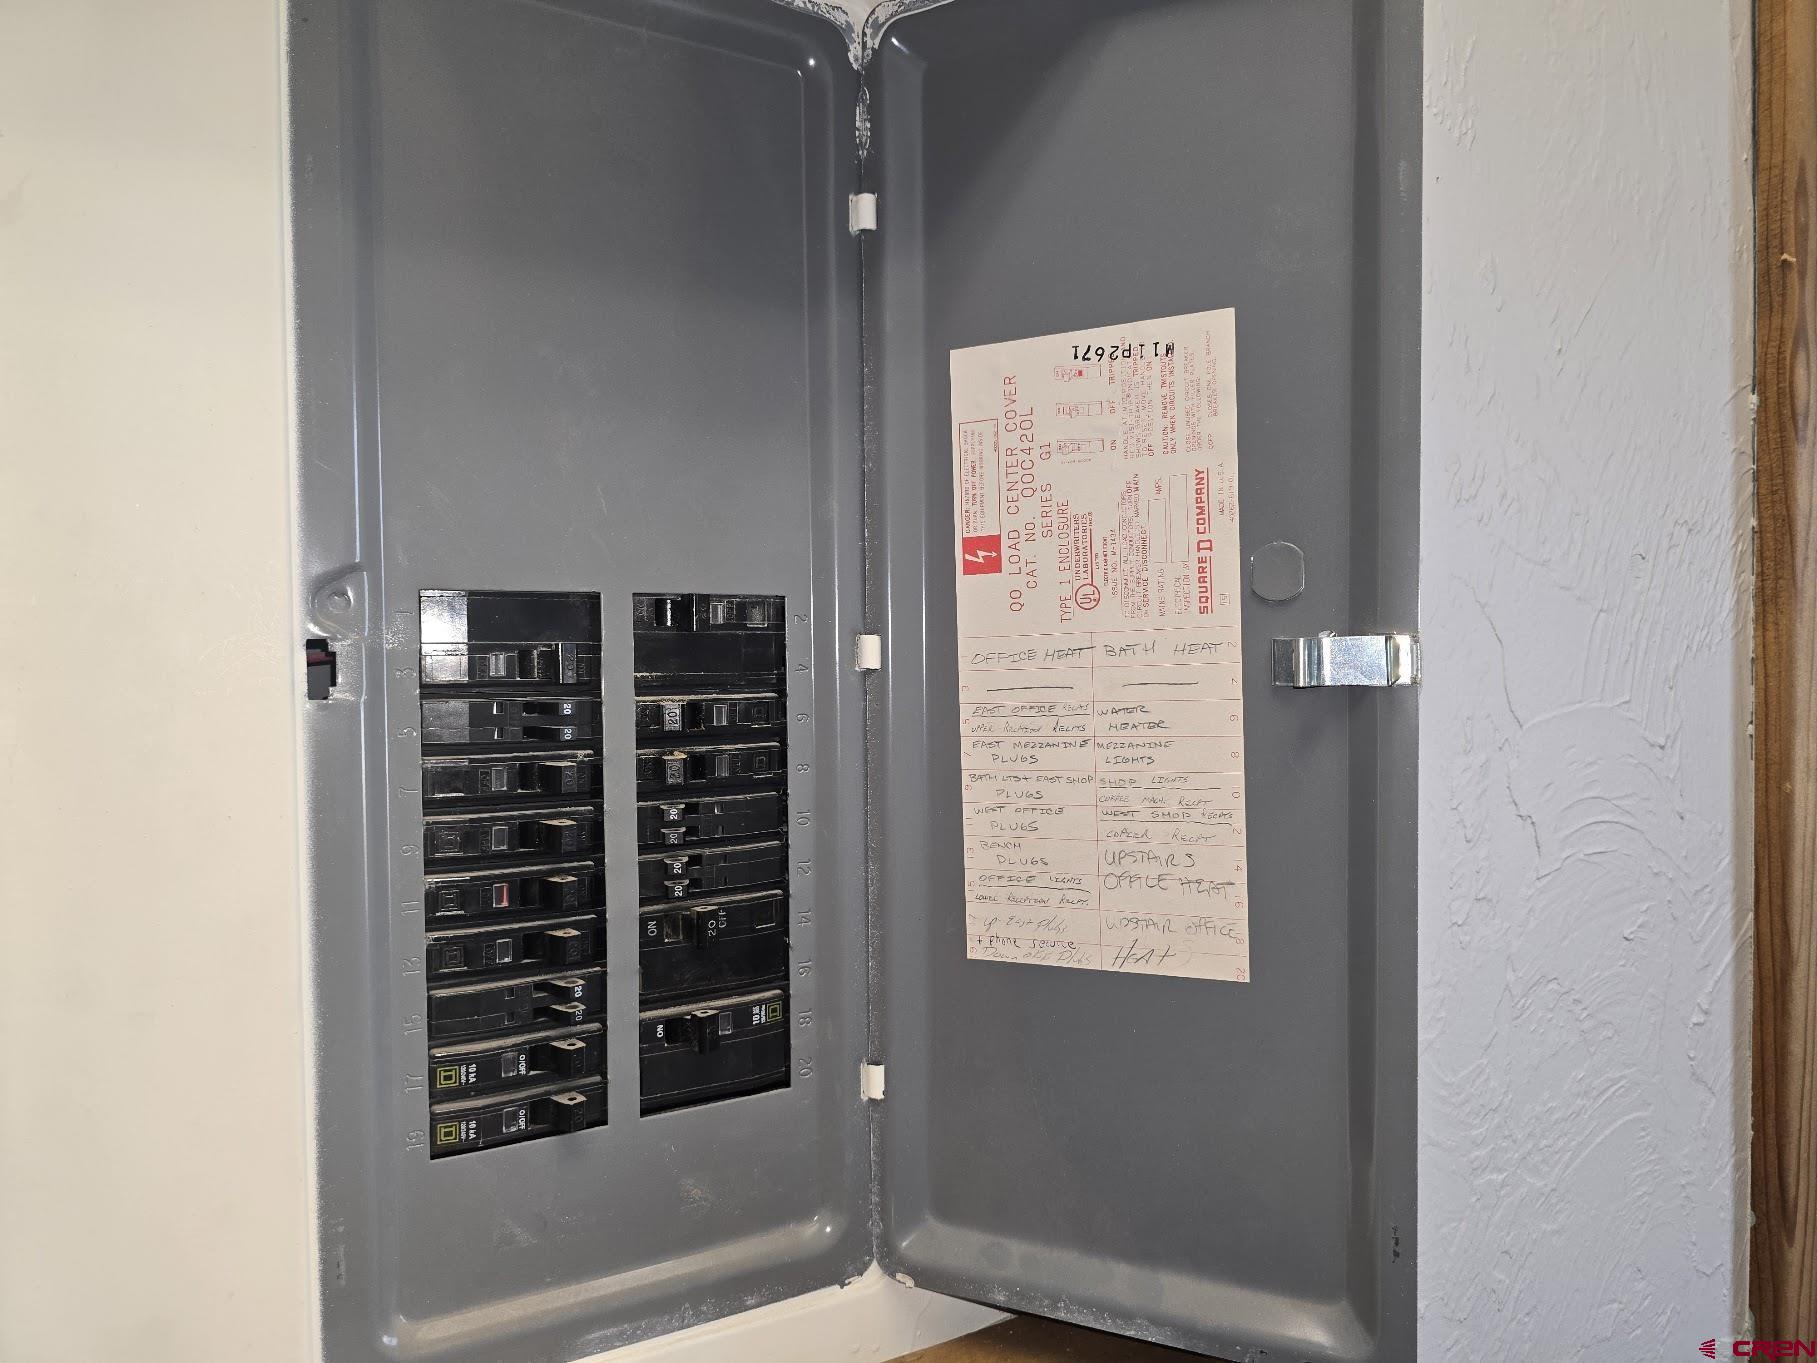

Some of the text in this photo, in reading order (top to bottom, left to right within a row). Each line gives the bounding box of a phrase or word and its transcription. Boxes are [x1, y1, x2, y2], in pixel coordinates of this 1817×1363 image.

[1109, 439, 1117, 450] ON
[1161, 424, 1169, 455] CAUTION:
[1169, 437, 1177, 454] ONLY
[1003, 375, 1025, 612] QO LOAD CENTER COVER
[1039, 441, 1053, 539] SERIES G1
[1024, 516, 1036, 542] NO.
[1072, 513, 1082, 581] UNDERWRITERS
[1080, 513, 1090, 581] LABORATORIES
[1195, 468, 1213, 615] SQUARE D COMPANY
[1057, 499, 1072, 623] TYPE 1 ENCLOSURE
[1025, 554, 1038, 589] CAT.
[1103, 640, 1223, 657] BATH HEAT
[971, 646, 1096, 665] OFFICE HEAT
[563, 703, 572, 715] 20
[972, 704, 1057, 715] EAST OFFICE
[1096, 704, 1151, 716] WATER
[668, 711, 678, 726] 20
[795, 713, 810, 724] 6
[1108, 719, 1170, 731] HEATER
[563, 728, 573, 740] 20
[972, 739, 1092, 750] EAST MEZZANINE
[1096, 740, 1175, 750] MEZZANINE
[991, 753, 1040, 764] PLUGS
[1105, 755, 1155, 765] LIGHTS
[796, 763, 810, 774] 8
[969, 773, 1094, 784] BATH EAST SHOP
[1098, 775, 1190, 786] SHOP LIGHTS
[996, 789, 1045, 800] PLUGS
[670, 808, 678, 820] 20
[973, 806, 1066, 815] WEST OFFICE
[1101, 810, 1192, 819] WEST SHOP
[796, 809, 811, 827] 10
[990, 820, 1040, 832] PLUGS
[670, 833, 677, 844] 20
[979, 840, 1022, 850] BENCH
[1104, 849, 1196, 868] UPSTAIRS
[674, 862, 682, 874] 20
[797, 860, 812, 877] 12
[978, 874, 1083, 885] OFFICE LIGHTS
[1103, 871, 1235, 899] OFFICE HEAT
[675, 885, 683, 897] 20
[718, 909, 727, 928] OFF
[797, 909, 812, 927] 14
[647, 920, 657, 936] ON
[1105, 914, 1239, 939] UPSTAIR OFFICE
[574, 985, 583, 998] 20
[574, 1009, 584, 1021] 20
[797, 1009, 813, 1028] 18
[656, 1024, 664, 1037] ON
[468, 1063, 477, 1073] 10
[798, 1056, 813, 1078] 20
[468, 1120, 477, 1130] 10
